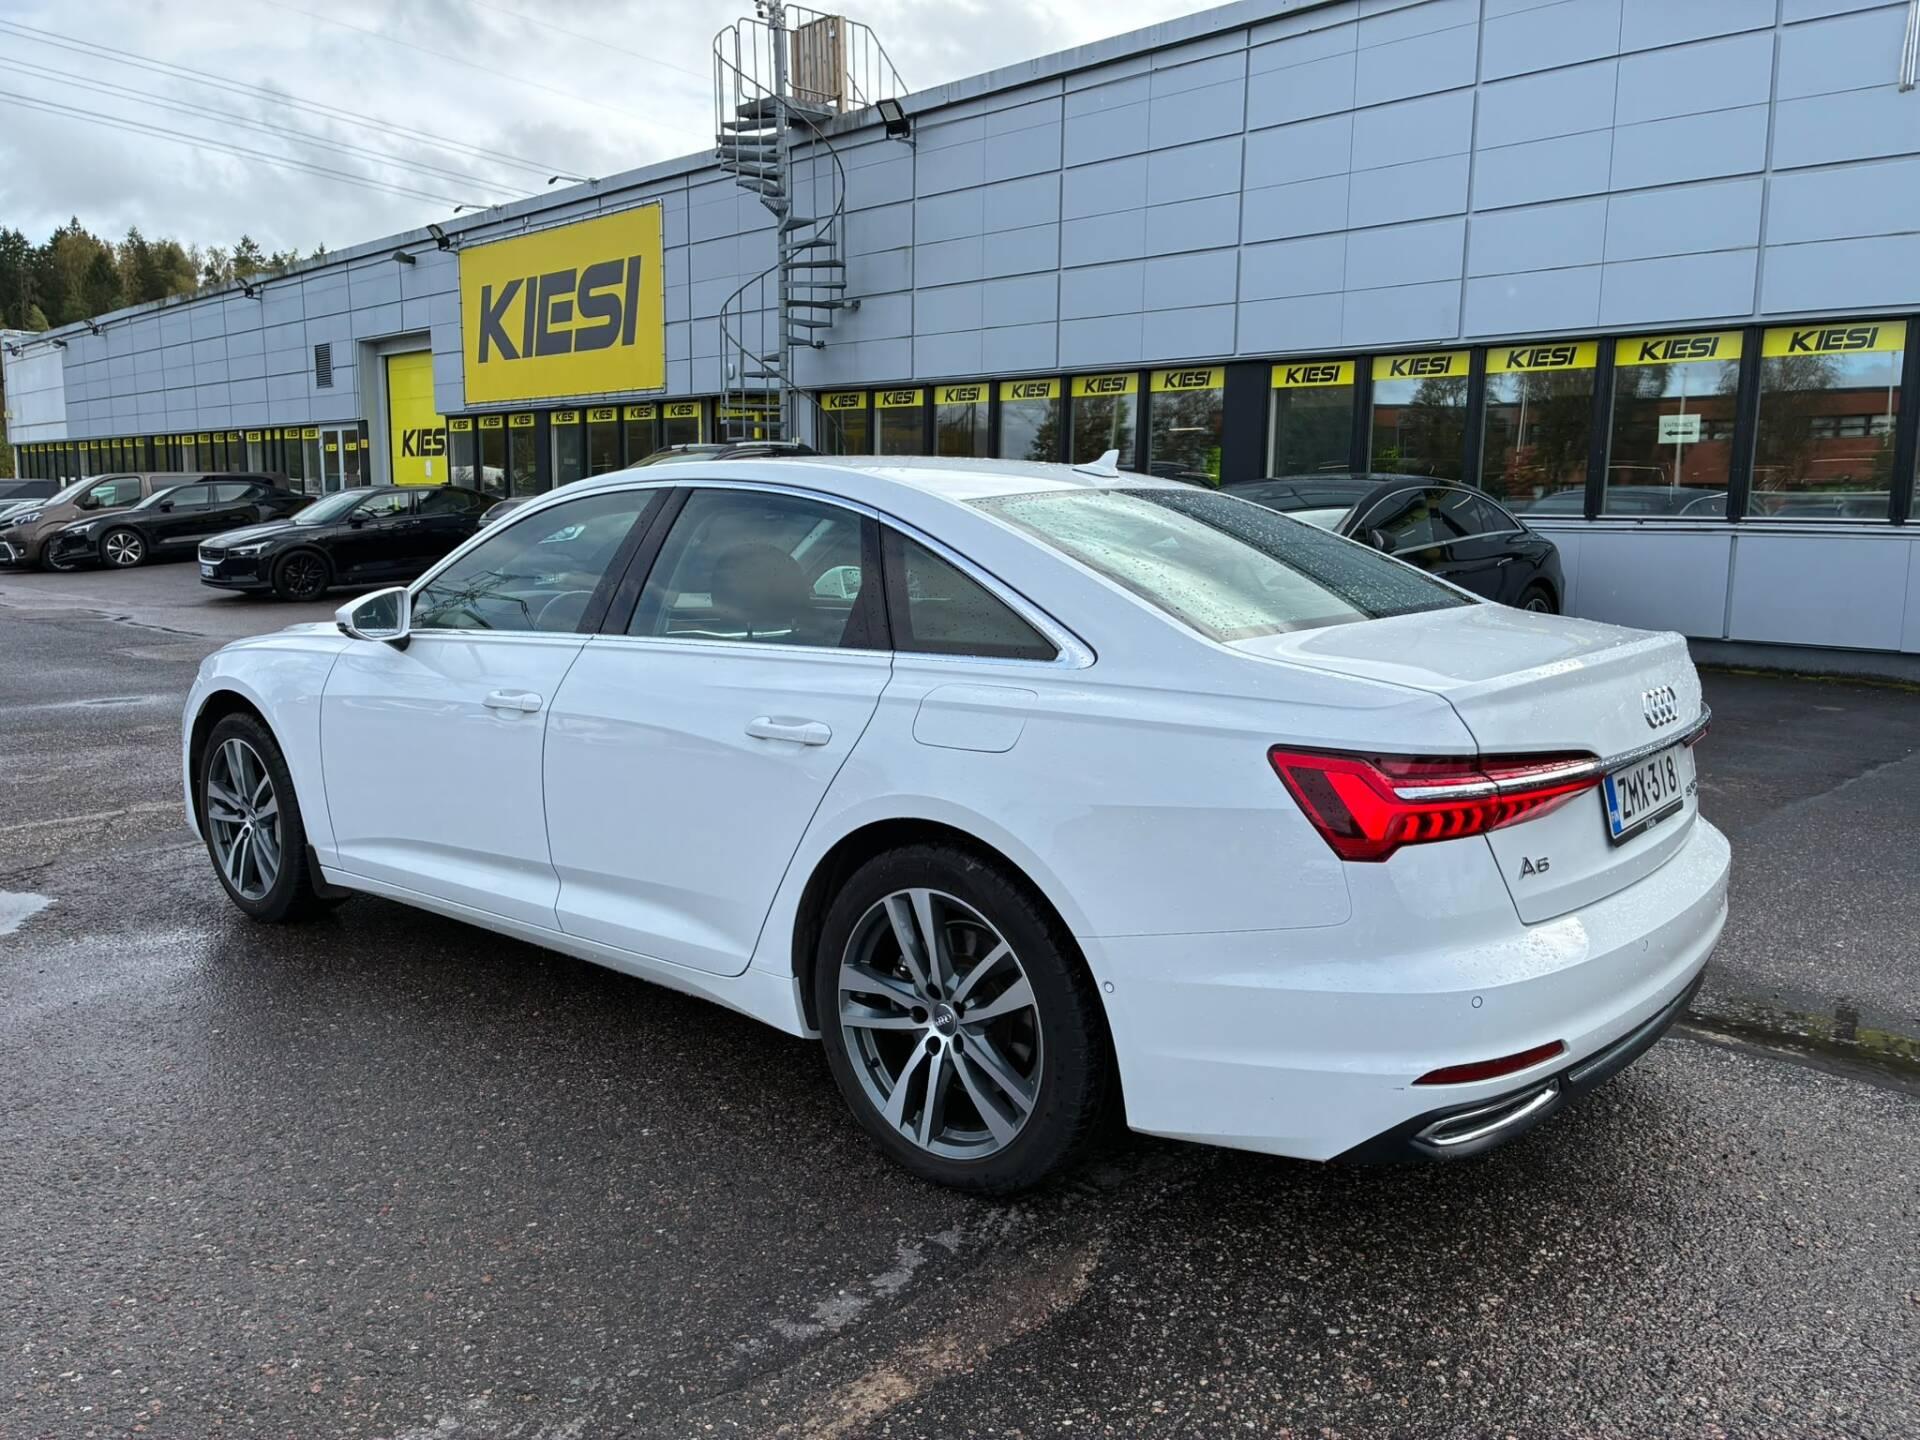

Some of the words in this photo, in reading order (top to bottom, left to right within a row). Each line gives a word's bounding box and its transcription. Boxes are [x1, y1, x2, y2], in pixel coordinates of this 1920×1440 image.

[478, 255, 641, 363] KIESI
[1638, 336, 1720, 361] KIESI
[1788, 327, 1879, 353] KIESI
[1390, 356, 1453, 376] KIESI
[1506, 346, 1577, 368] KIESI
[1164, 371, 1211, 388] KIESI
[1285, 366, 1340, 384] KIESI
[1011, 383, 1051, 398] KIESI
[1084, 377, 1128, 393] KIESI
[829, 394, 860, 408] KIESI
[882, 391, 915, 406] KIESI
[944, 387, 981, 403] KIESI
[592, 409, 613, 421] KIESI
[670, 404, 694, 417] KIESI
[401, 427, 448, 457] KIES
[1617, 755, 1677, 820] ZMX-318
[1518, 856, 1550, 881] A6
